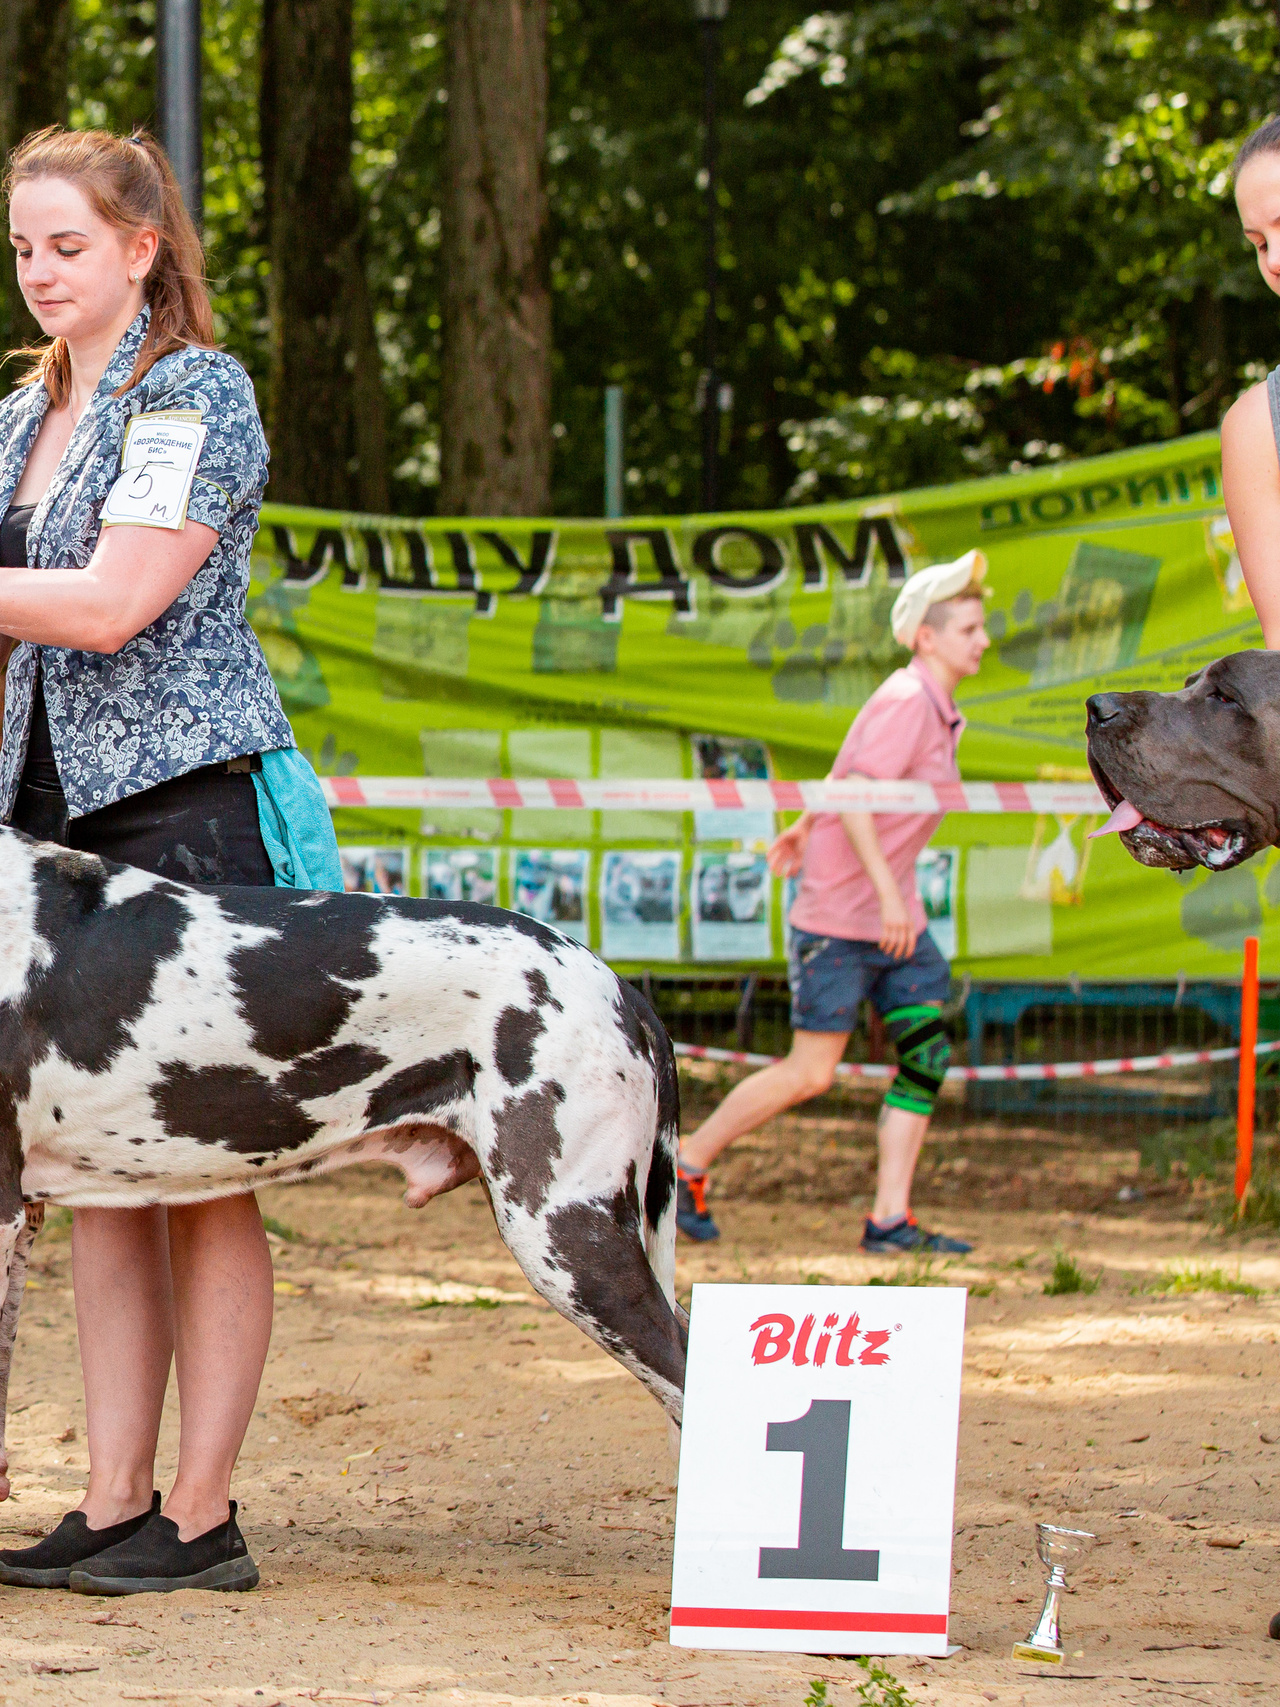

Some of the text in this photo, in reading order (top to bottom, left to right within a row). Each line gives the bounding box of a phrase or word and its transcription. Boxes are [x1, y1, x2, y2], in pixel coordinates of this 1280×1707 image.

[133, 437, 193, 450] «ВОЗРОЖДЕНИЕ
[147, 446, 167, 454] БИС»
[128, 461, 174, 499] 5
[272, 518, 908, 623] ИЩУ ДОМ
[749, 1311, 893, 1369] Blitz
[757, 1398, 880, 1582] 1
